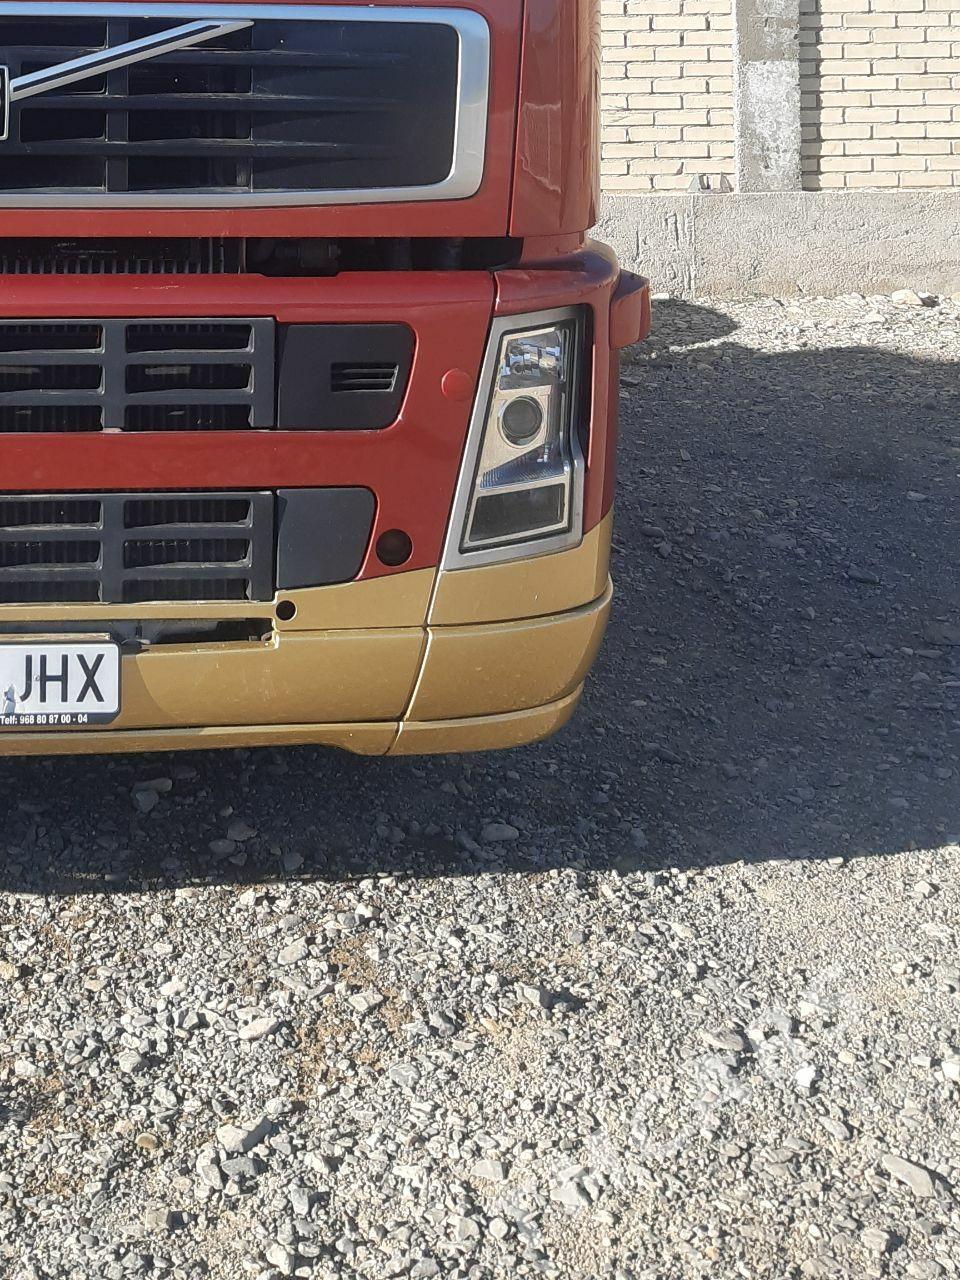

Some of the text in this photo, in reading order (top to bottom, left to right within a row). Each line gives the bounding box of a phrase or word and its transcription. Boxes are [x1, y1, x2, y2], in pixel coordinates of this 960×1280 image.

[19, 653, 105, 703] JHX
[0, 715, 18, 724] Telf:
[20, 715, 34, 724] 968
[37, 715, 46, 723] 80
[49, 715, 58, 723] 87
[61, 714, 71, 723] 00
[77, 714, 88, 723] 04
